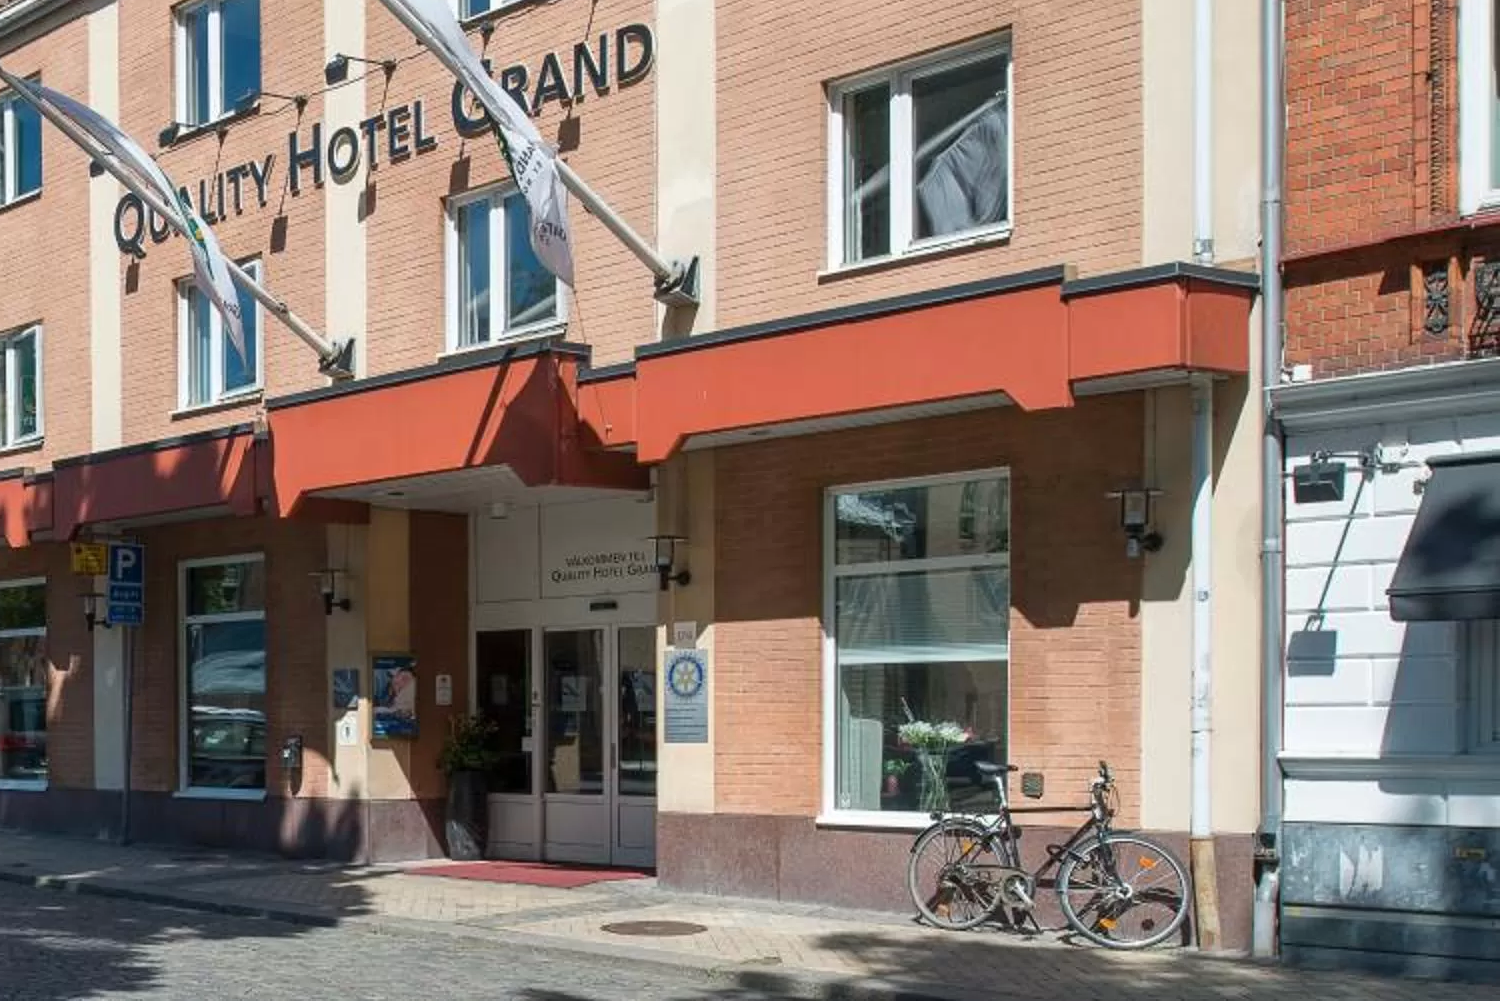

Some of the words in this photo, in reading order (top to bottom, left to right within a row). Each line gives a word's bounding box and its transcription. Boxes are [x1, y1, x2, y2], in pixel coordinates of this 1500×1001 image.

[289, 101, 435, 192] HOTEL
[116, 548, 137, 579] P
[593, 566, 624, 580] HOTEL
